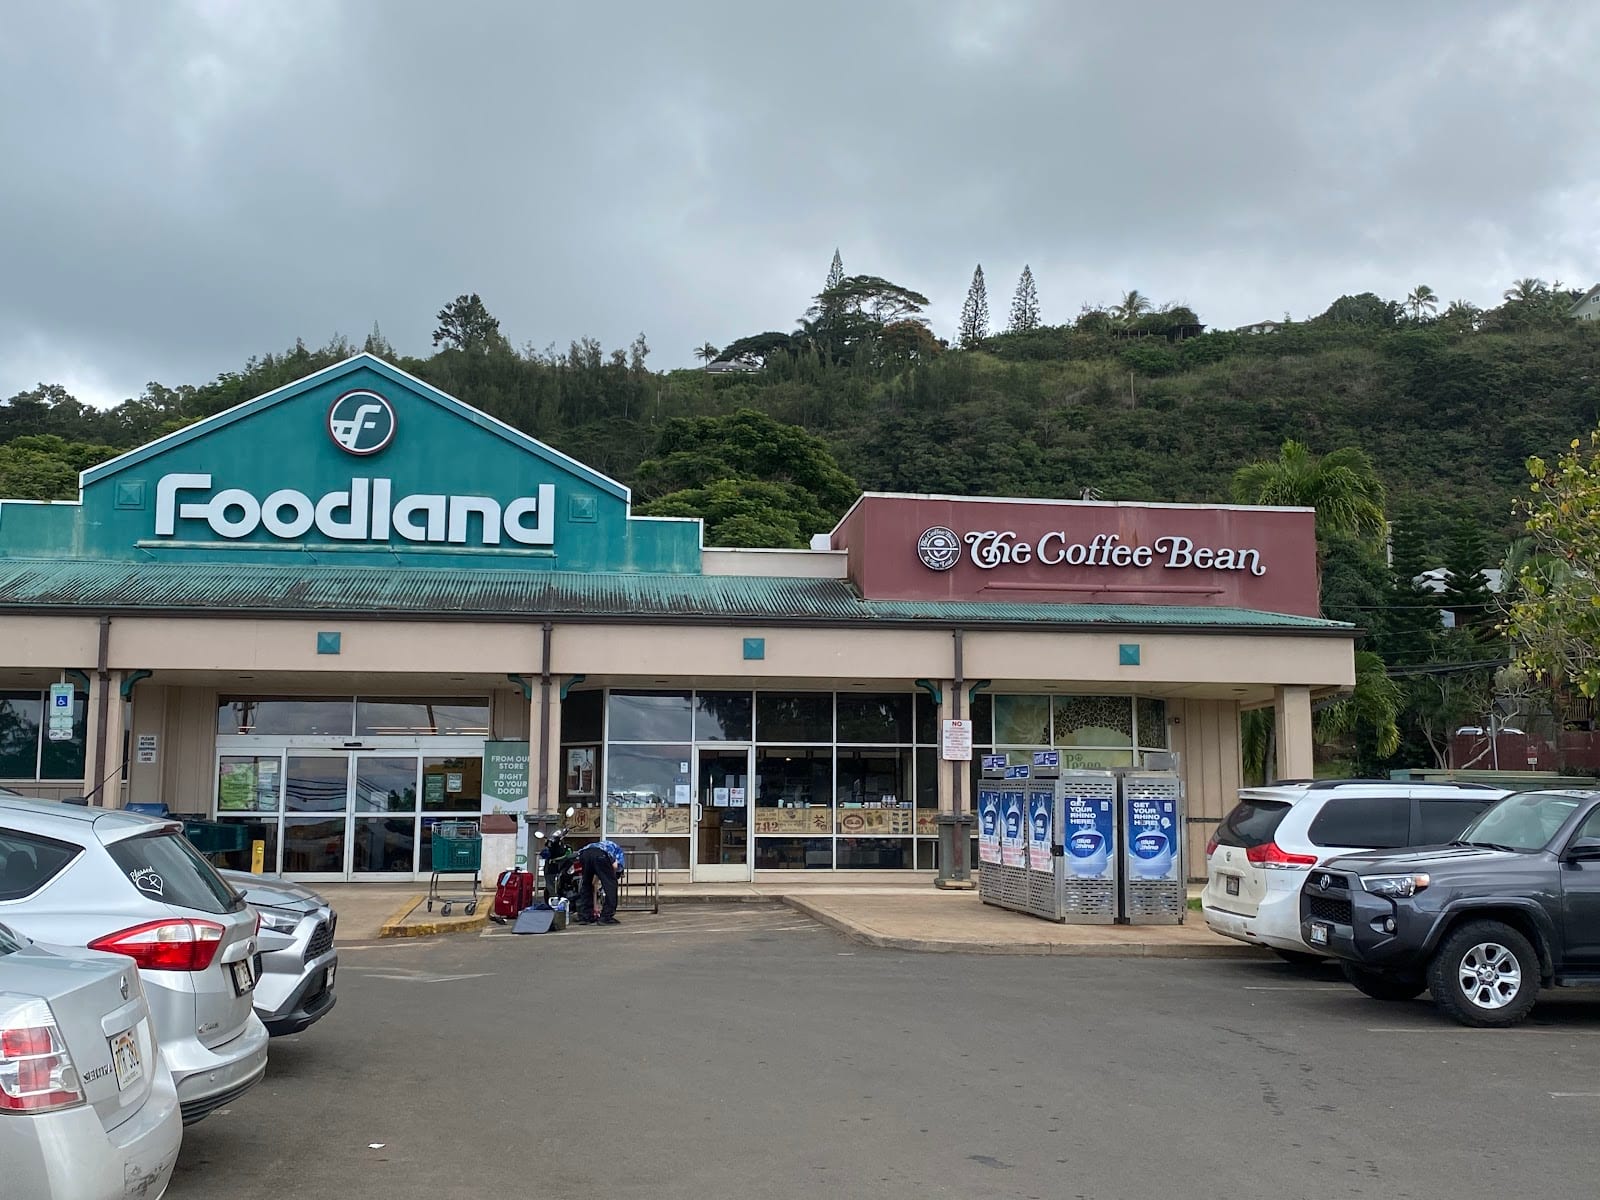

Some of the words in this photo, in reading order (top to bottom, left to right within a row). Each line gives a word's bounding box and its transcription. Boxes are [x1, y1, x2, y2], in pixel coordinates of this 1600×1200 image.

[964, 531, 1032, 568] The
[1037, 531, 1153, 566] Coffee
[1154, 536, 1267, 576] Bean
[129, 865, 155, 882] Blessed
